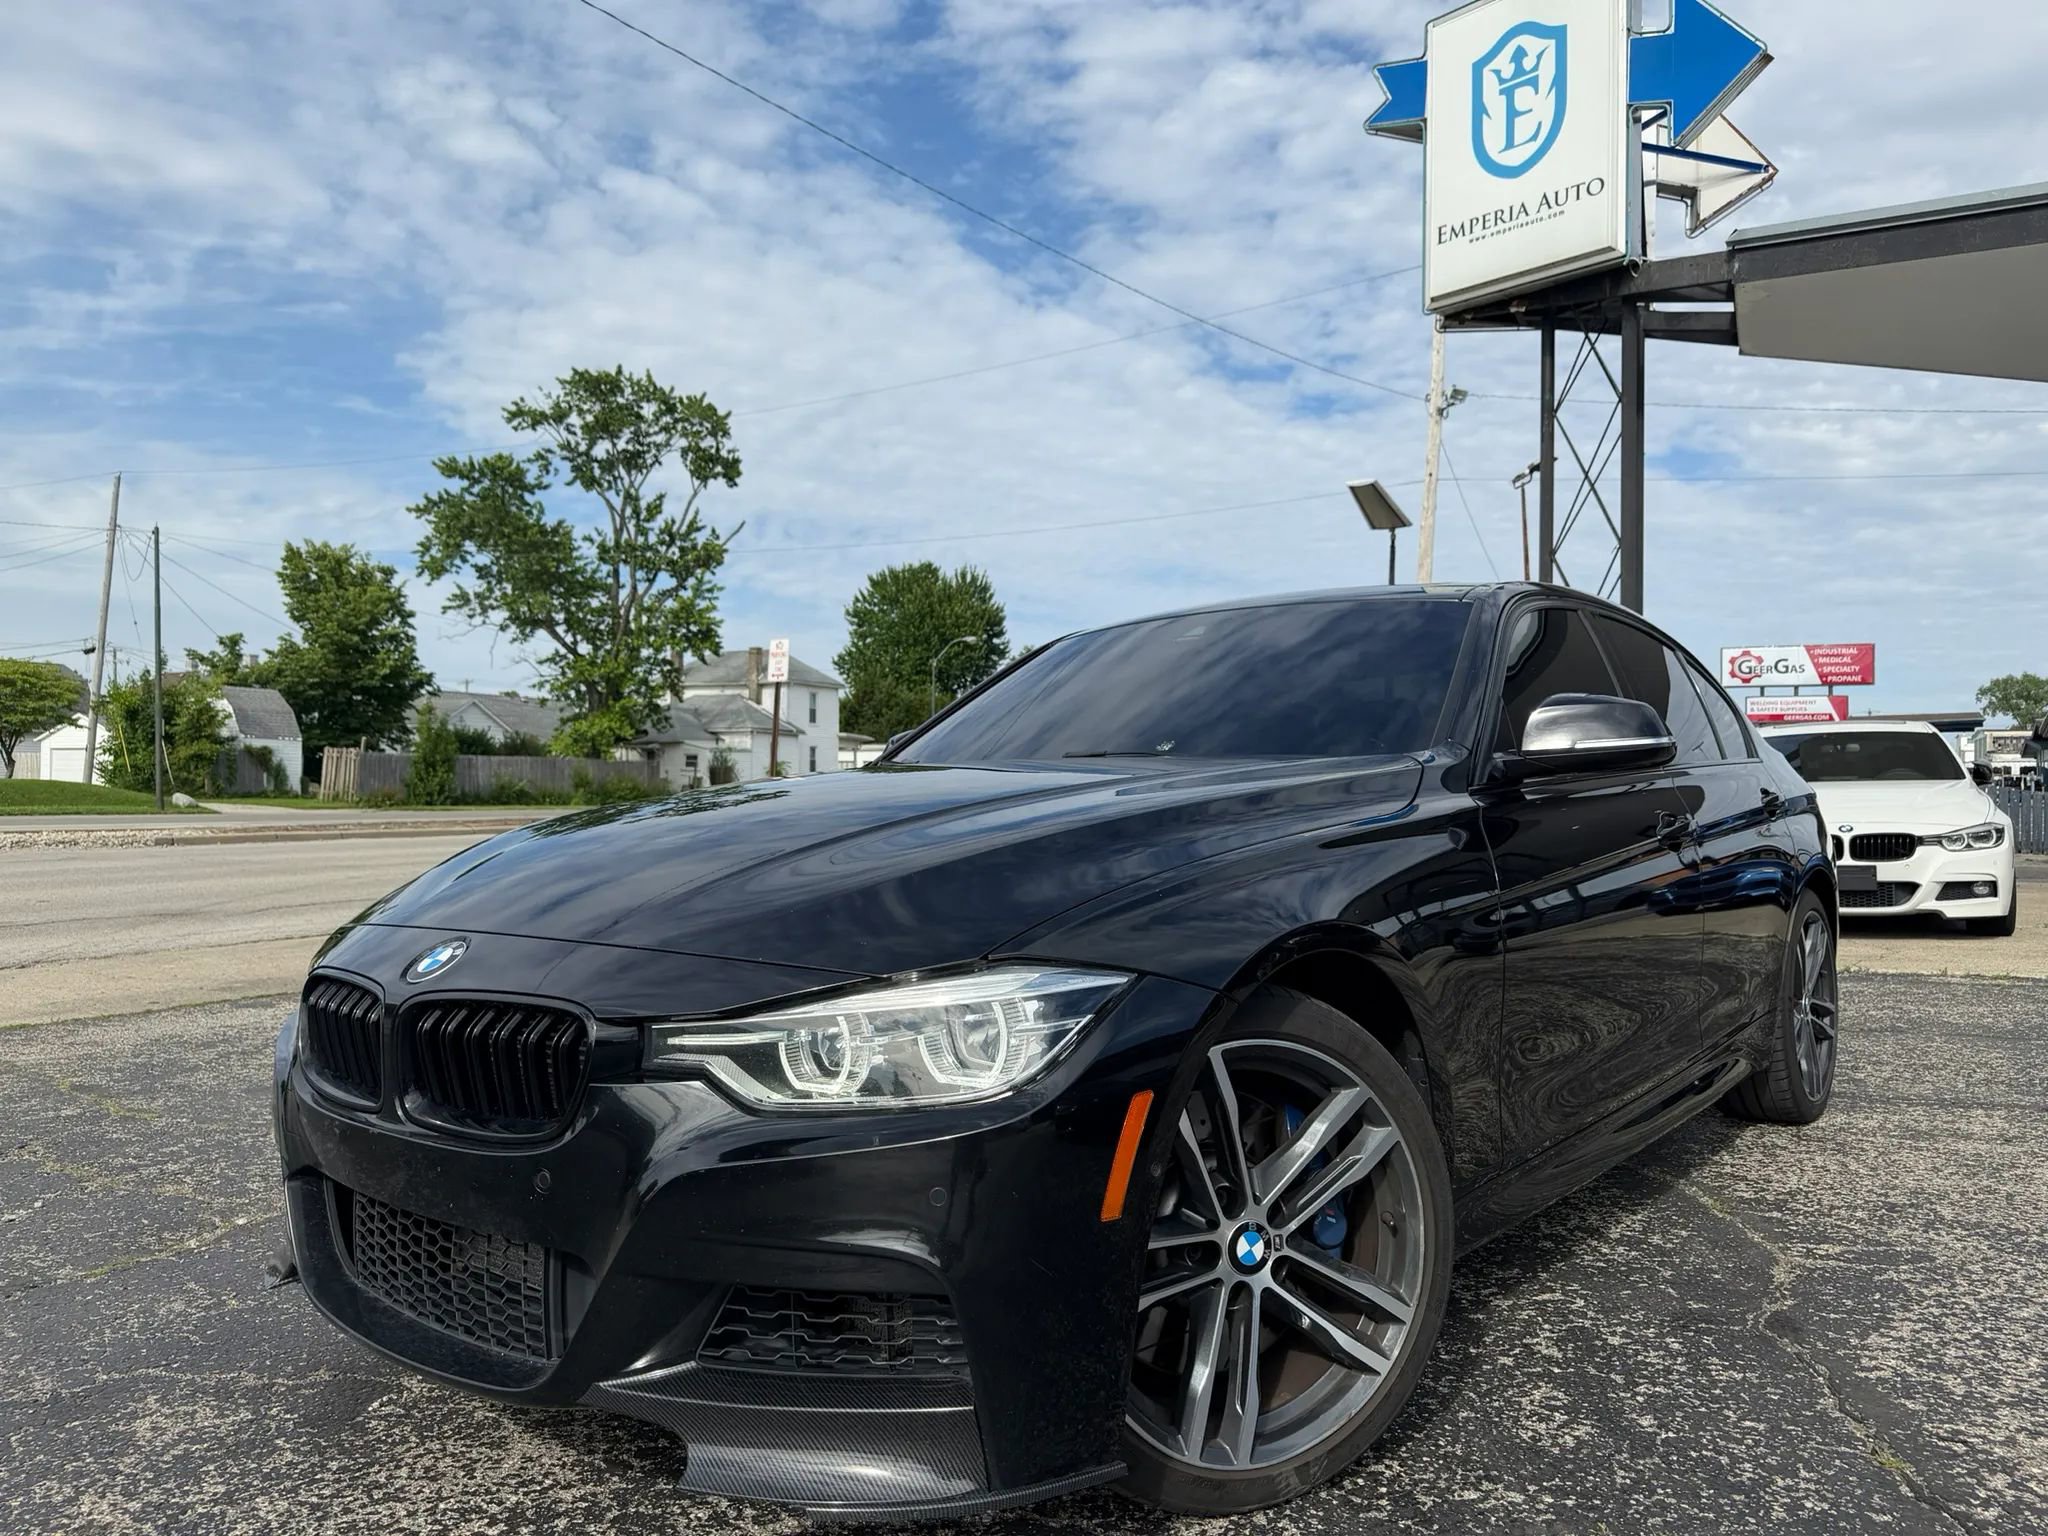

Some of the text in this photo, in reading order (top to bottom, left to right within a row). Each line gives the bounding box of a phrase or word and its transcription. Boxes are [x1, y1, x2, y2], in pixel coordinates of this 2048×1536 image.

[1498, 73, 1542, 154] E
[1437, 177, 1605, 246] EMPERIA AUTO
[1468, 209, 1565, 244] www.emperiaauto.com
[1814, 647, 1858, 655] INDUSTRIAL
[1818, 656, 1852, 664] MEDICAL
[1822, 665, 1860, 673] SPECIALTY
[1827, 675, 1862, 683] PROPANE
